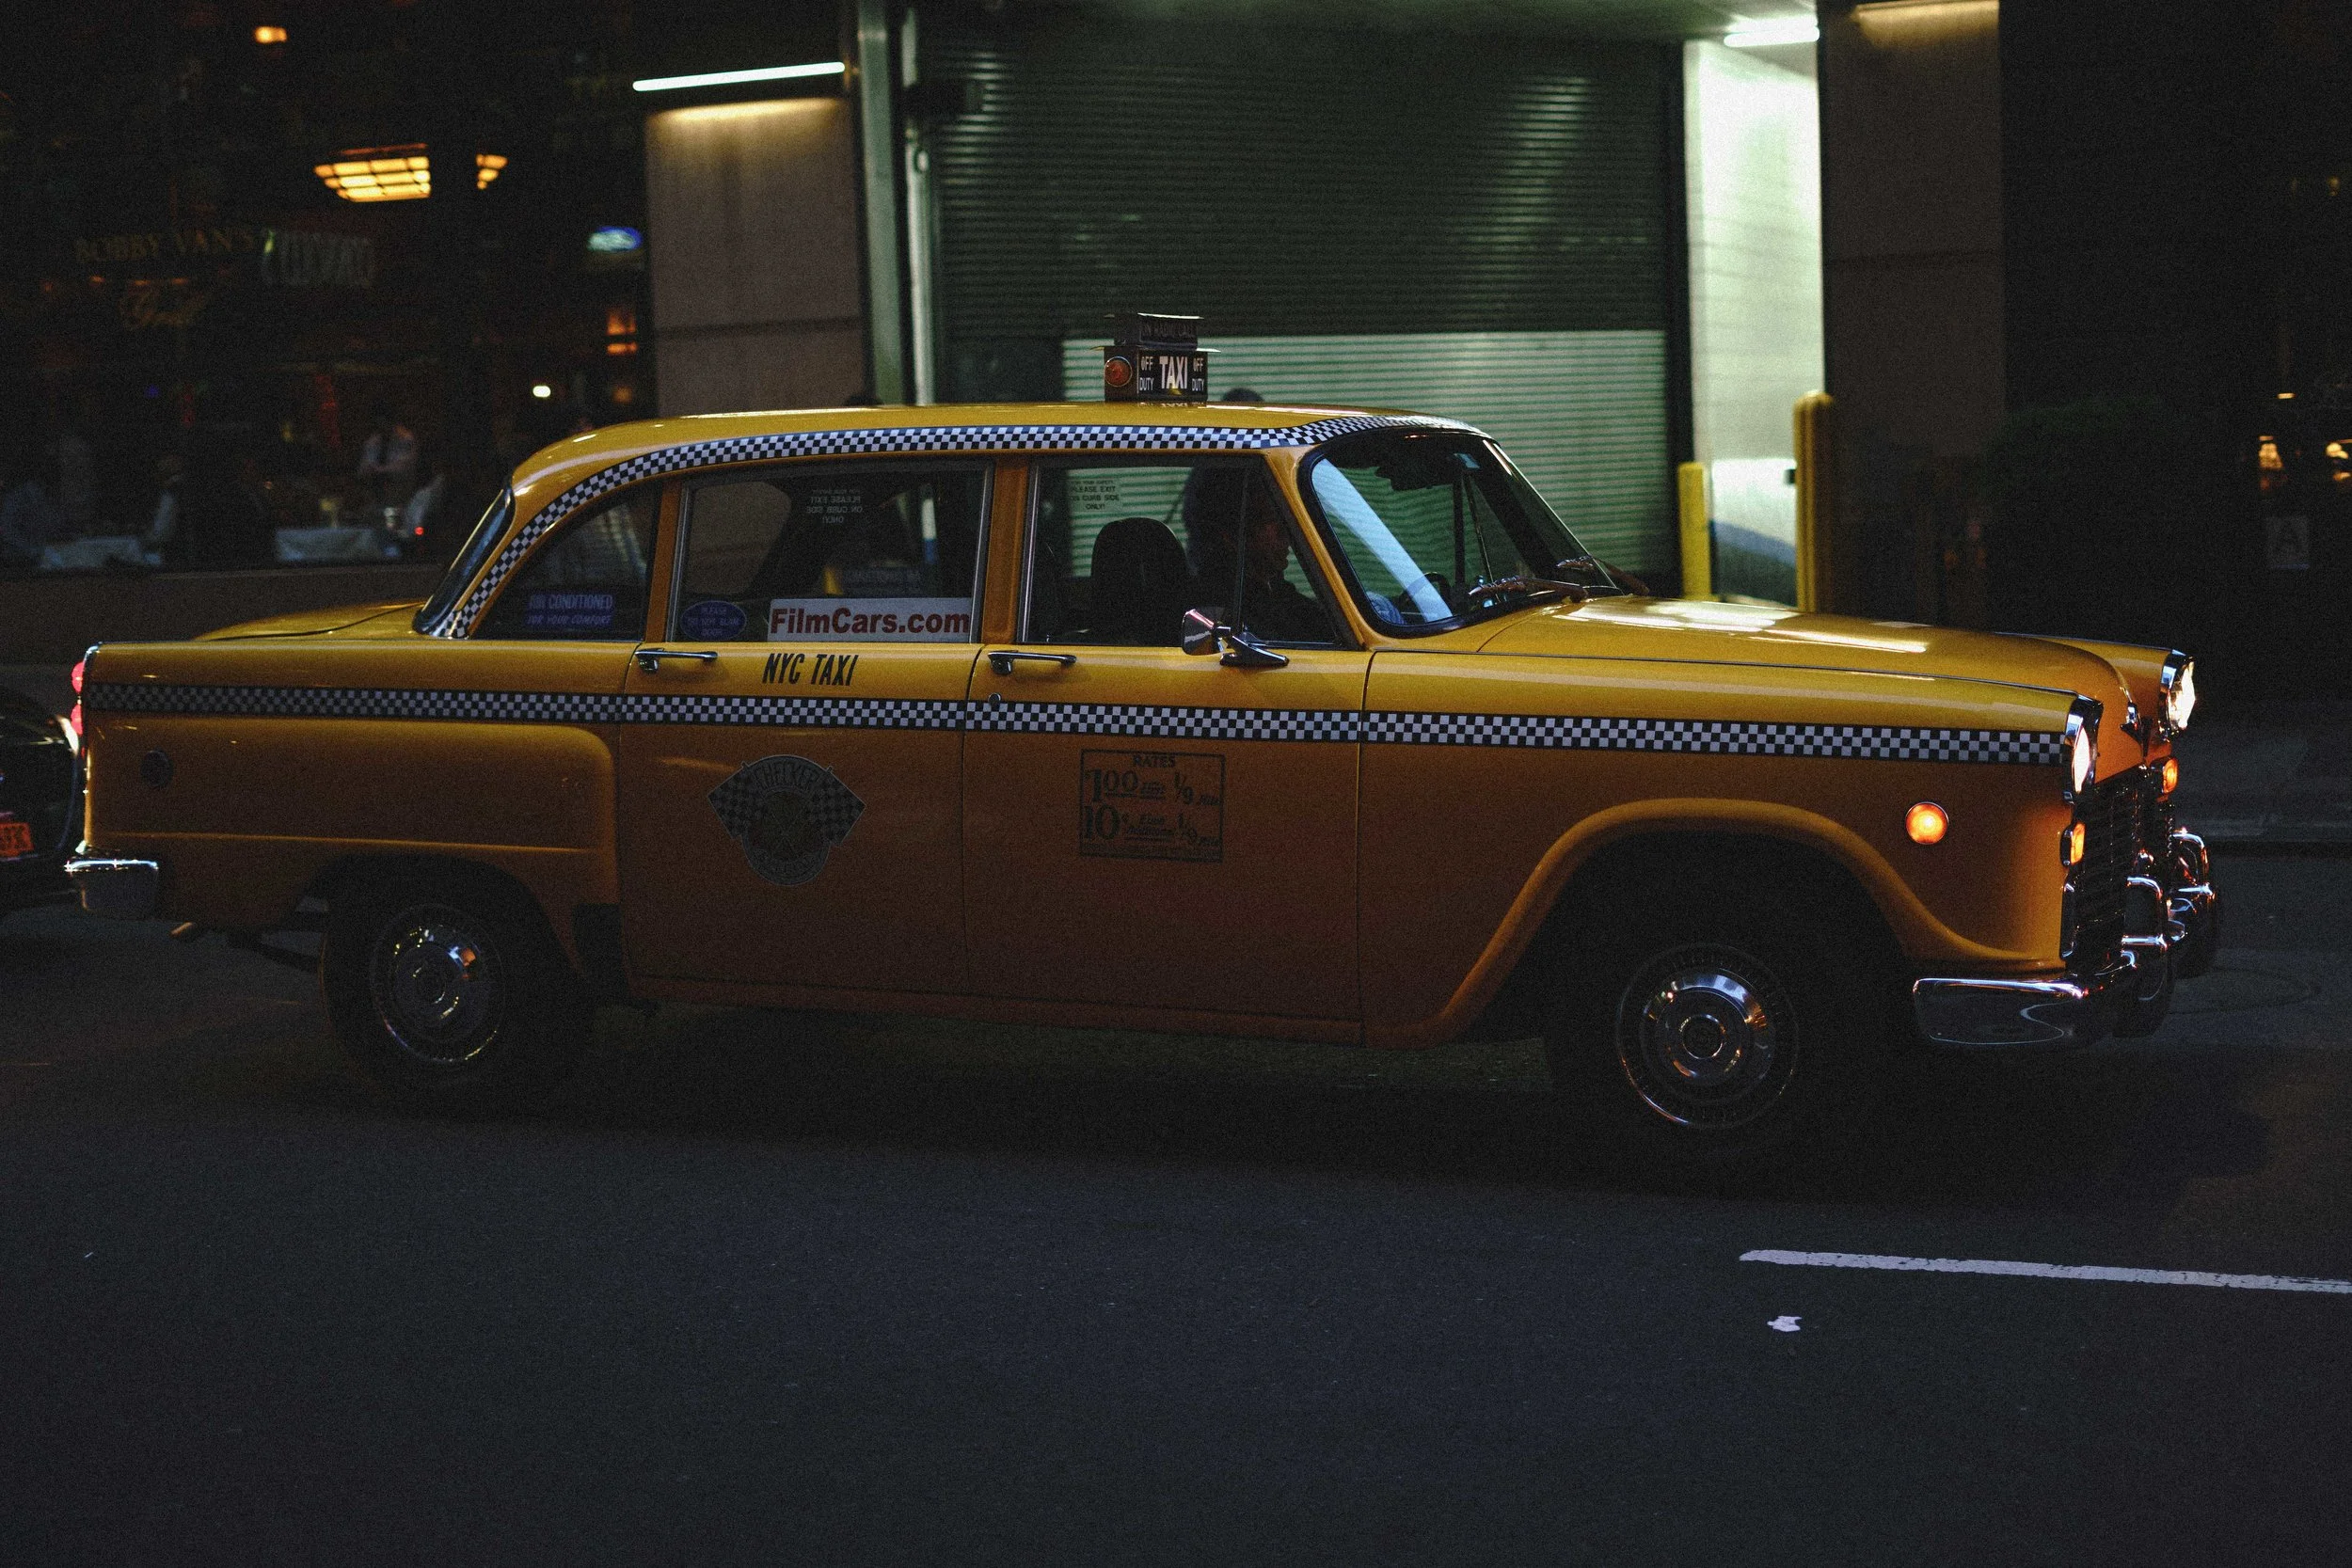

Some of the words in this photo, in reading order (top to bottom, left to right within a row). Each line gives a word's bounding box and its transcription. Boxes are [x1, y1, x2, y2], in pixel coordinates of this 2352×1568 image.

[1140, 356, 1154, 372] OFF
[1192, 357, 1204, 372] OFF
[1159, 356, 1188, 389] TAXI
[1139, 377, 1154, 391] DUTY
[1191, 378, 1205, 391] DUTY
[548, 594, 613, 610] CONDITIONED
[771, 607, 970, 634] FilmCars.com
[762, 652, 805, 684] NYC
[811, 654, 859, 686] TAXI
[1133, 754, 1176, 768] RATES
[754, 761, 819, 791] CHECKER
